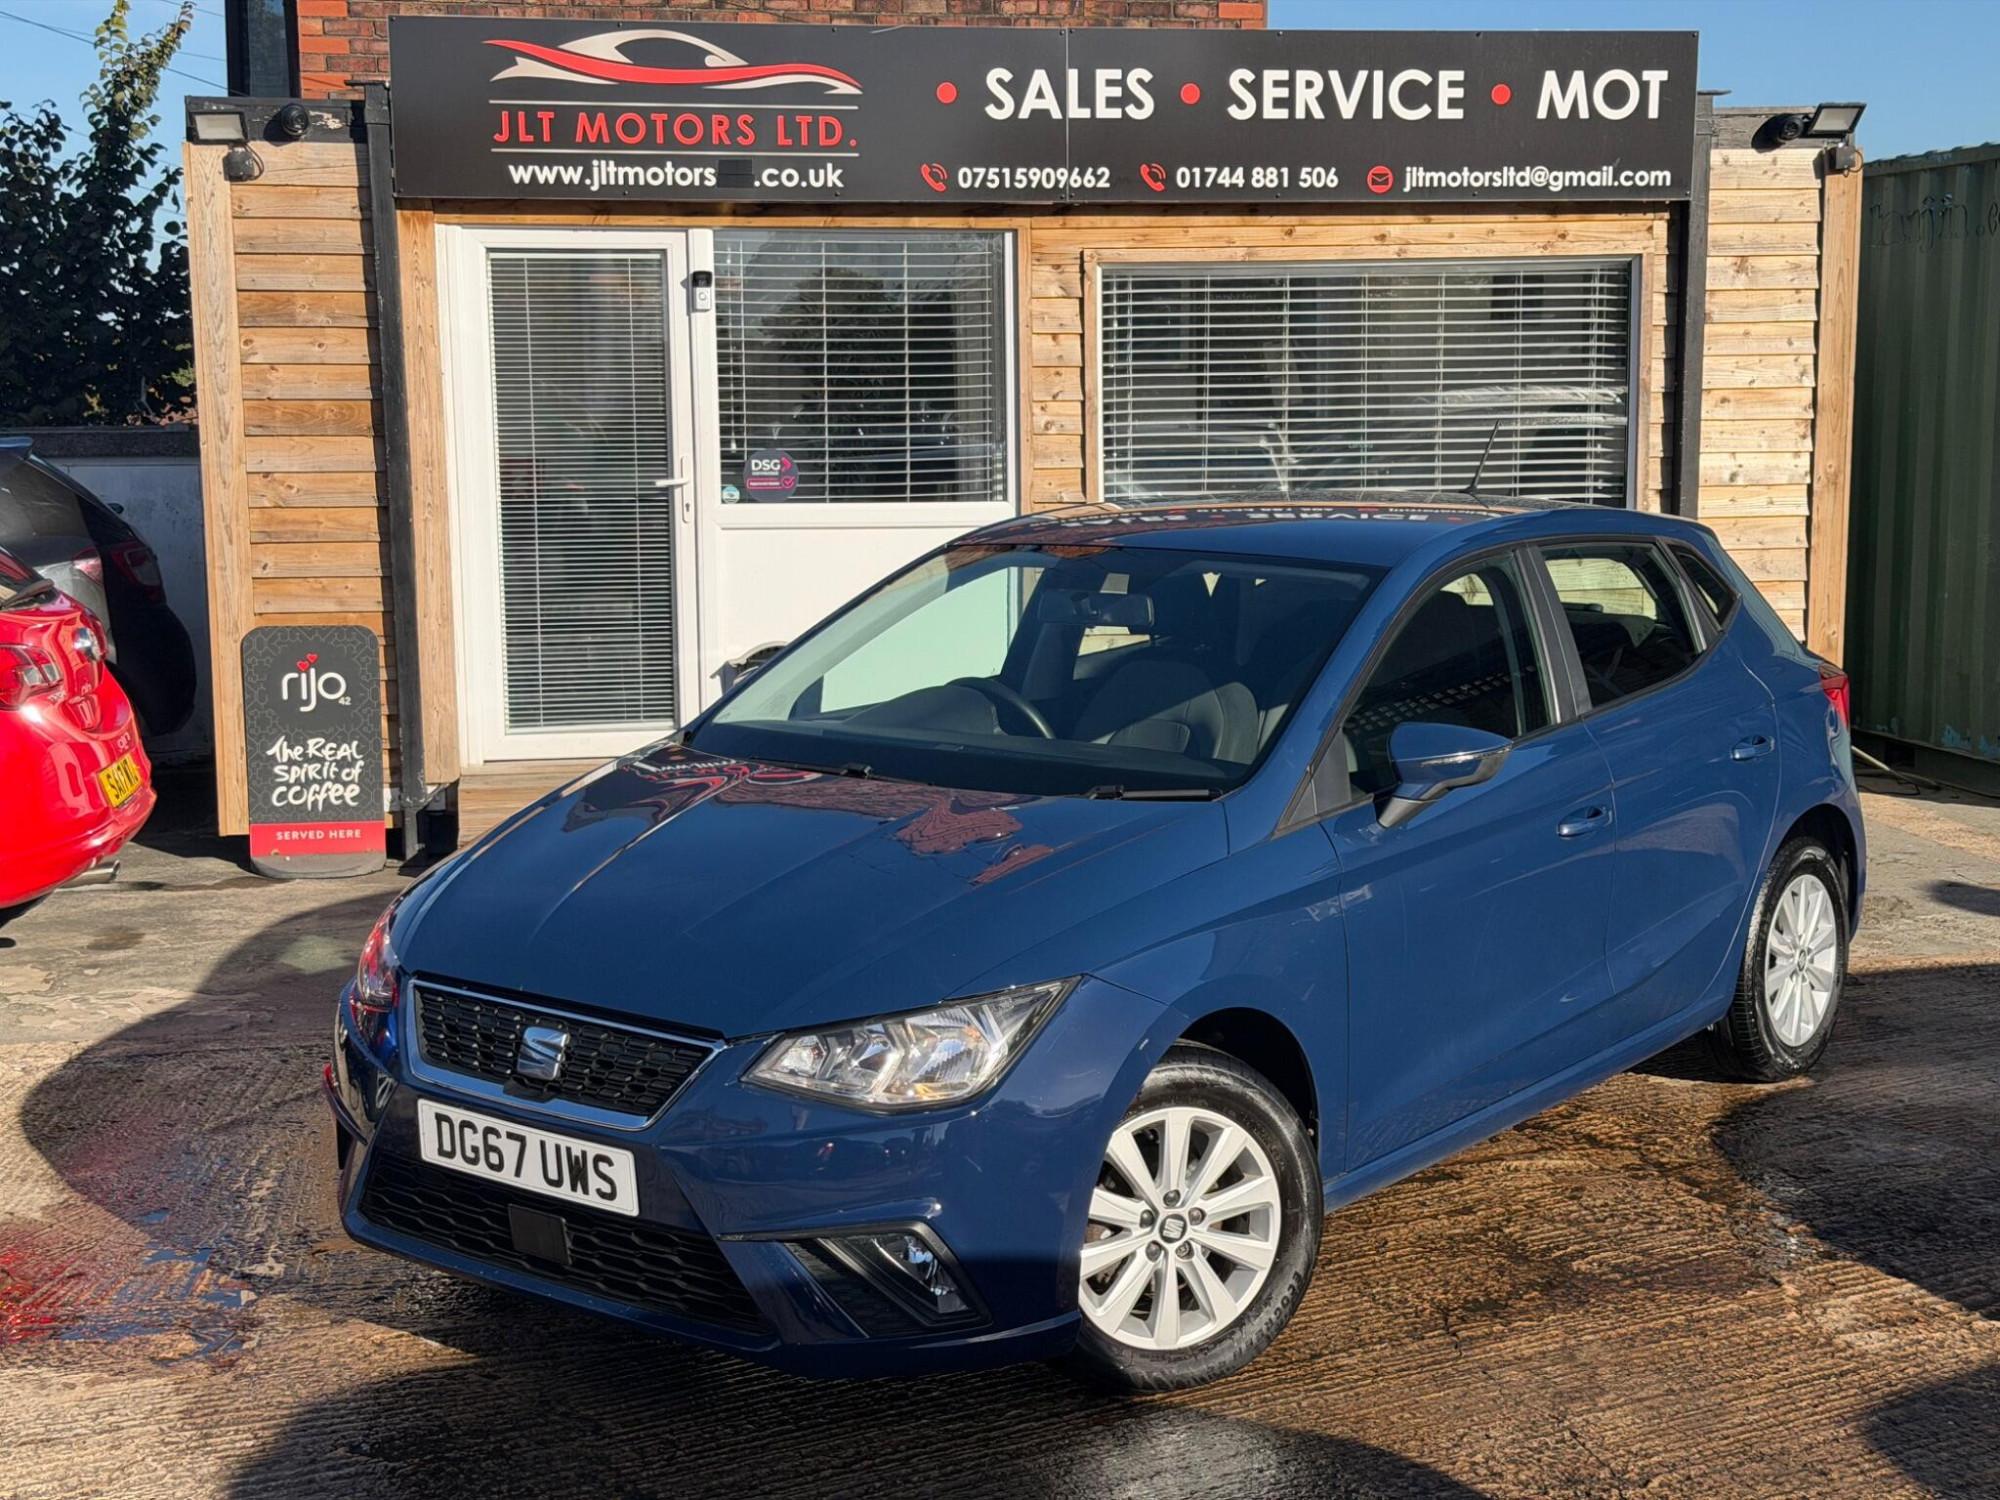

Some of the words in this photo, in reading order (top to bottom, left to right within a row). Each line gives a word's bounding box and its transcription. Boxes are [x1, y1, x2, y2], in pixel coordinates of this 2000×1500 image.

[984, 66, 1156, 123] SALES
[1227, 68, 1466, 122] SERVICE
[1537, 68, 1670, 122] MOT
[493, 111, 557, 143] JLT
[575, 112, 756, 146] MOTORS
[777, 115, 858, 148] LTD.
[957, 166, 1112, 191] 07515909662
[1176, 166, 1245, 189] 01744
[1251, 166, 1290, 189] 881
[1298, 166, 1339, 189] 506
[1402, 165, 1673, 194] jltmotorsltd@gmail.com
[751, 459, 781, 471] DSG
[281, 667, 347, 712] rijo
[265, 735, 304, 763] The
[305, 737, 364, 762] REAL
[341, 760, 365, 783] of
[271, 781, 361, 812] coffee
[276, 830, 325, 841] SERVED
[328, 829, 362, 839] HERE
[434, 1112, 527, 1178] DG67
[539, 1139, 618, 1202] UWS
